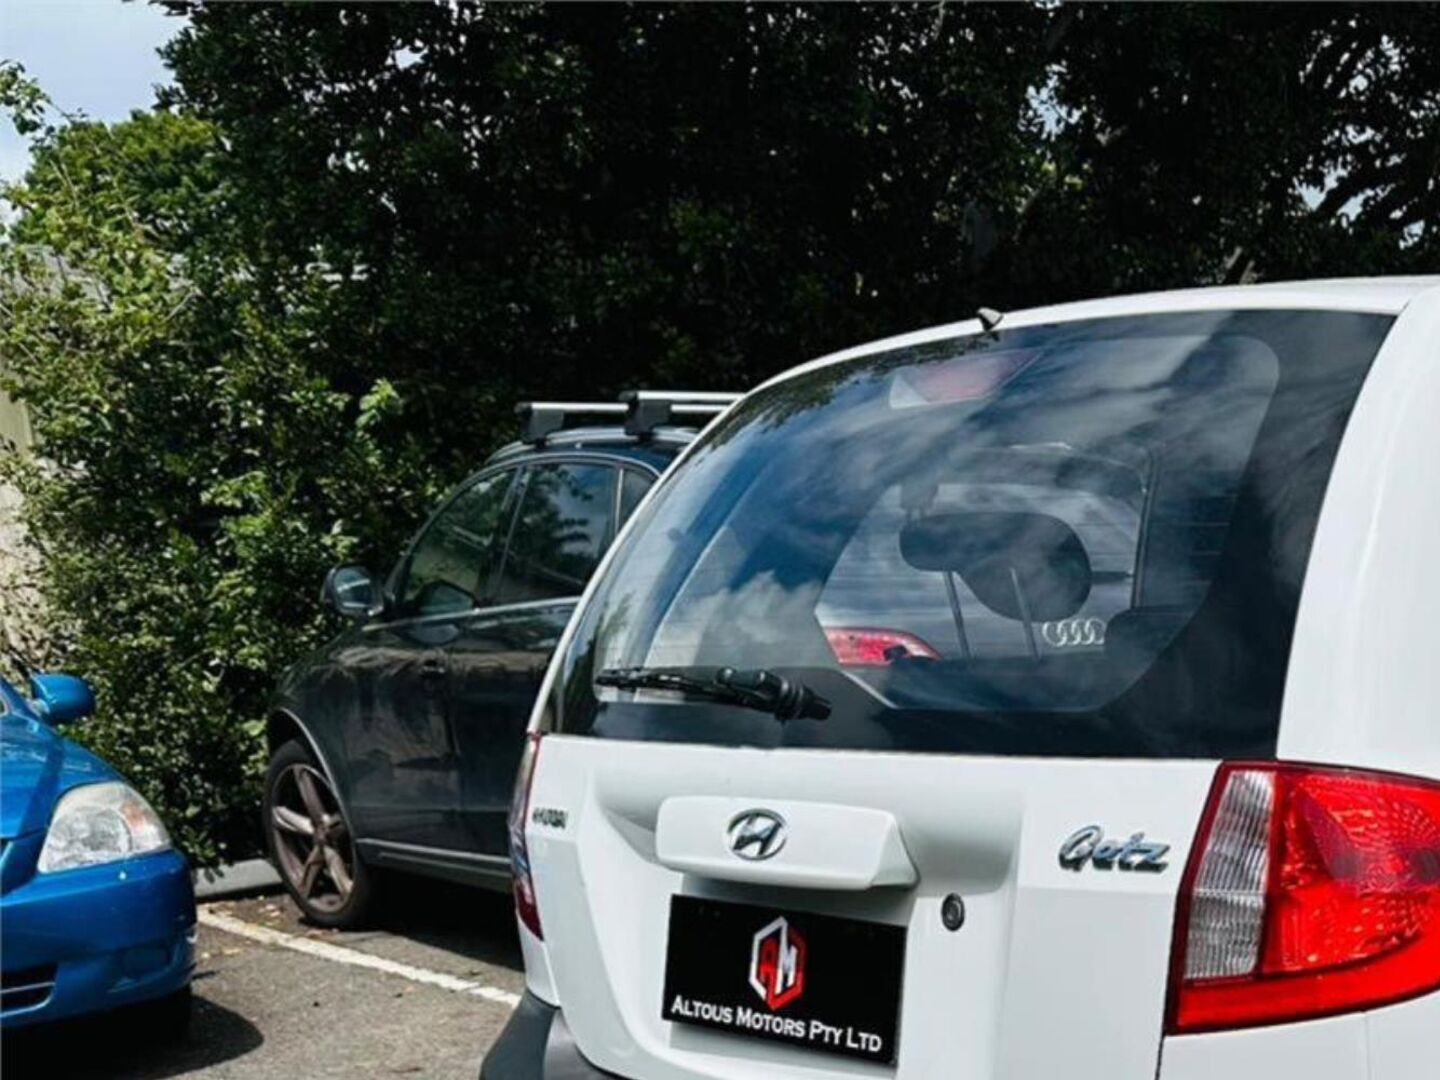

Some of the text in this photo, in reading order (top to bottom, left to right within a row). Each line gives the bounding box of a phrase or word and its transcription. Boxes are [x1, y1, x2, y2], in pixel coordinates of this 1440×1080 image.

[1058, 825, 1170, 873] Getz
[671, 995, 882, 1052] ALTOUS MOTORS PTY LTD
